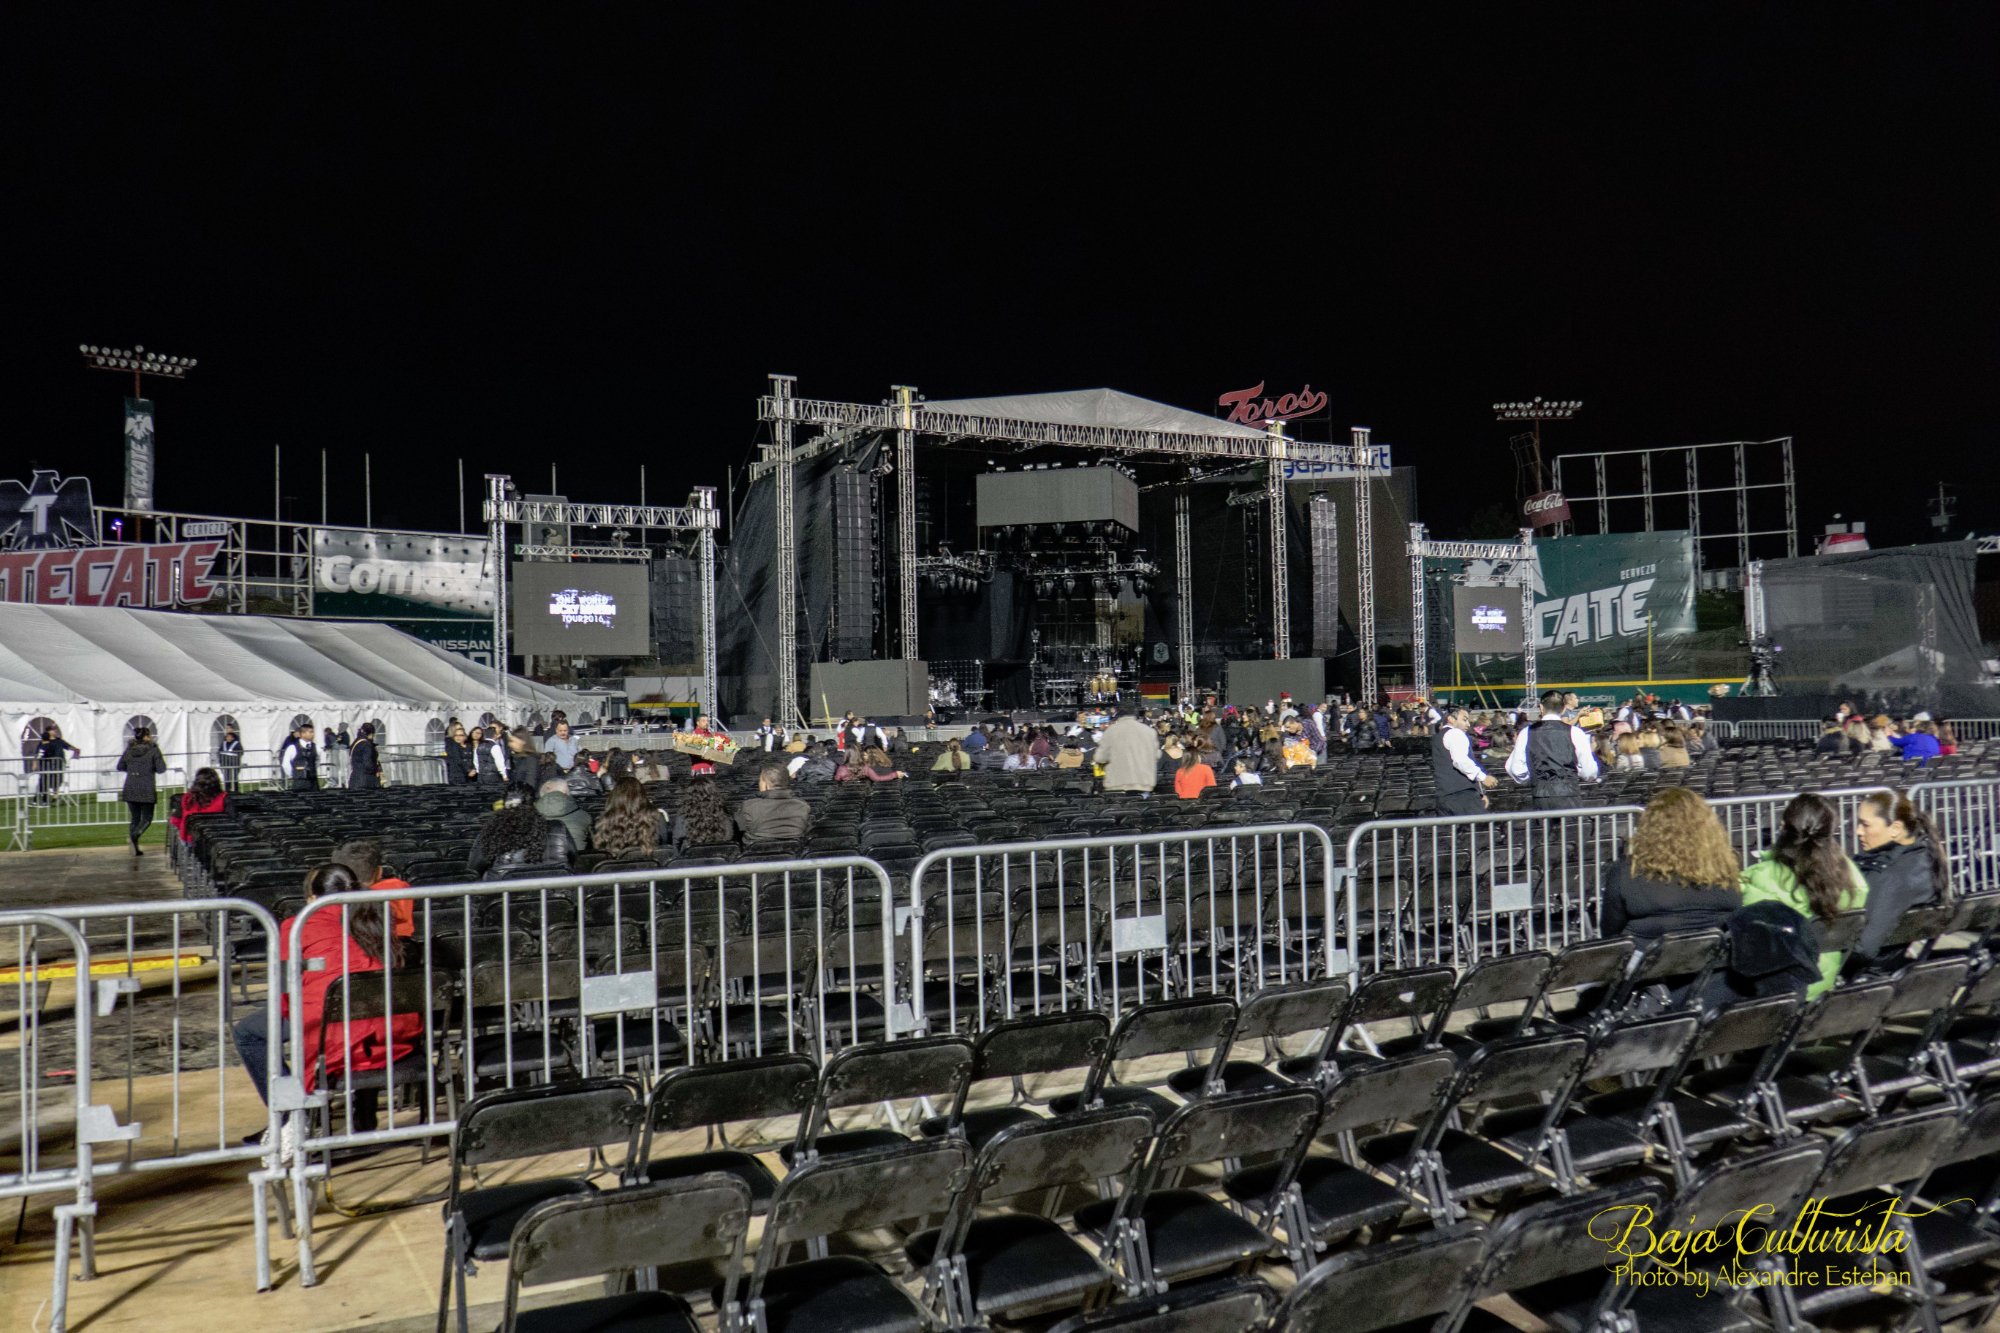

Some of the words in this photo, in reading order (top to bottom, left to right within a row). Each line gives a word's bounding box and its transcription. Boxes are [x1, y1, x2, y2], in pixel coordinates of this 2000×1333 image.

[1218, 380, 1328, 430] Toros
[130, 439, 149, 498] TECATE
[0, 540, 225, 606] TECATE
[319, 555, 478, 597] Come
